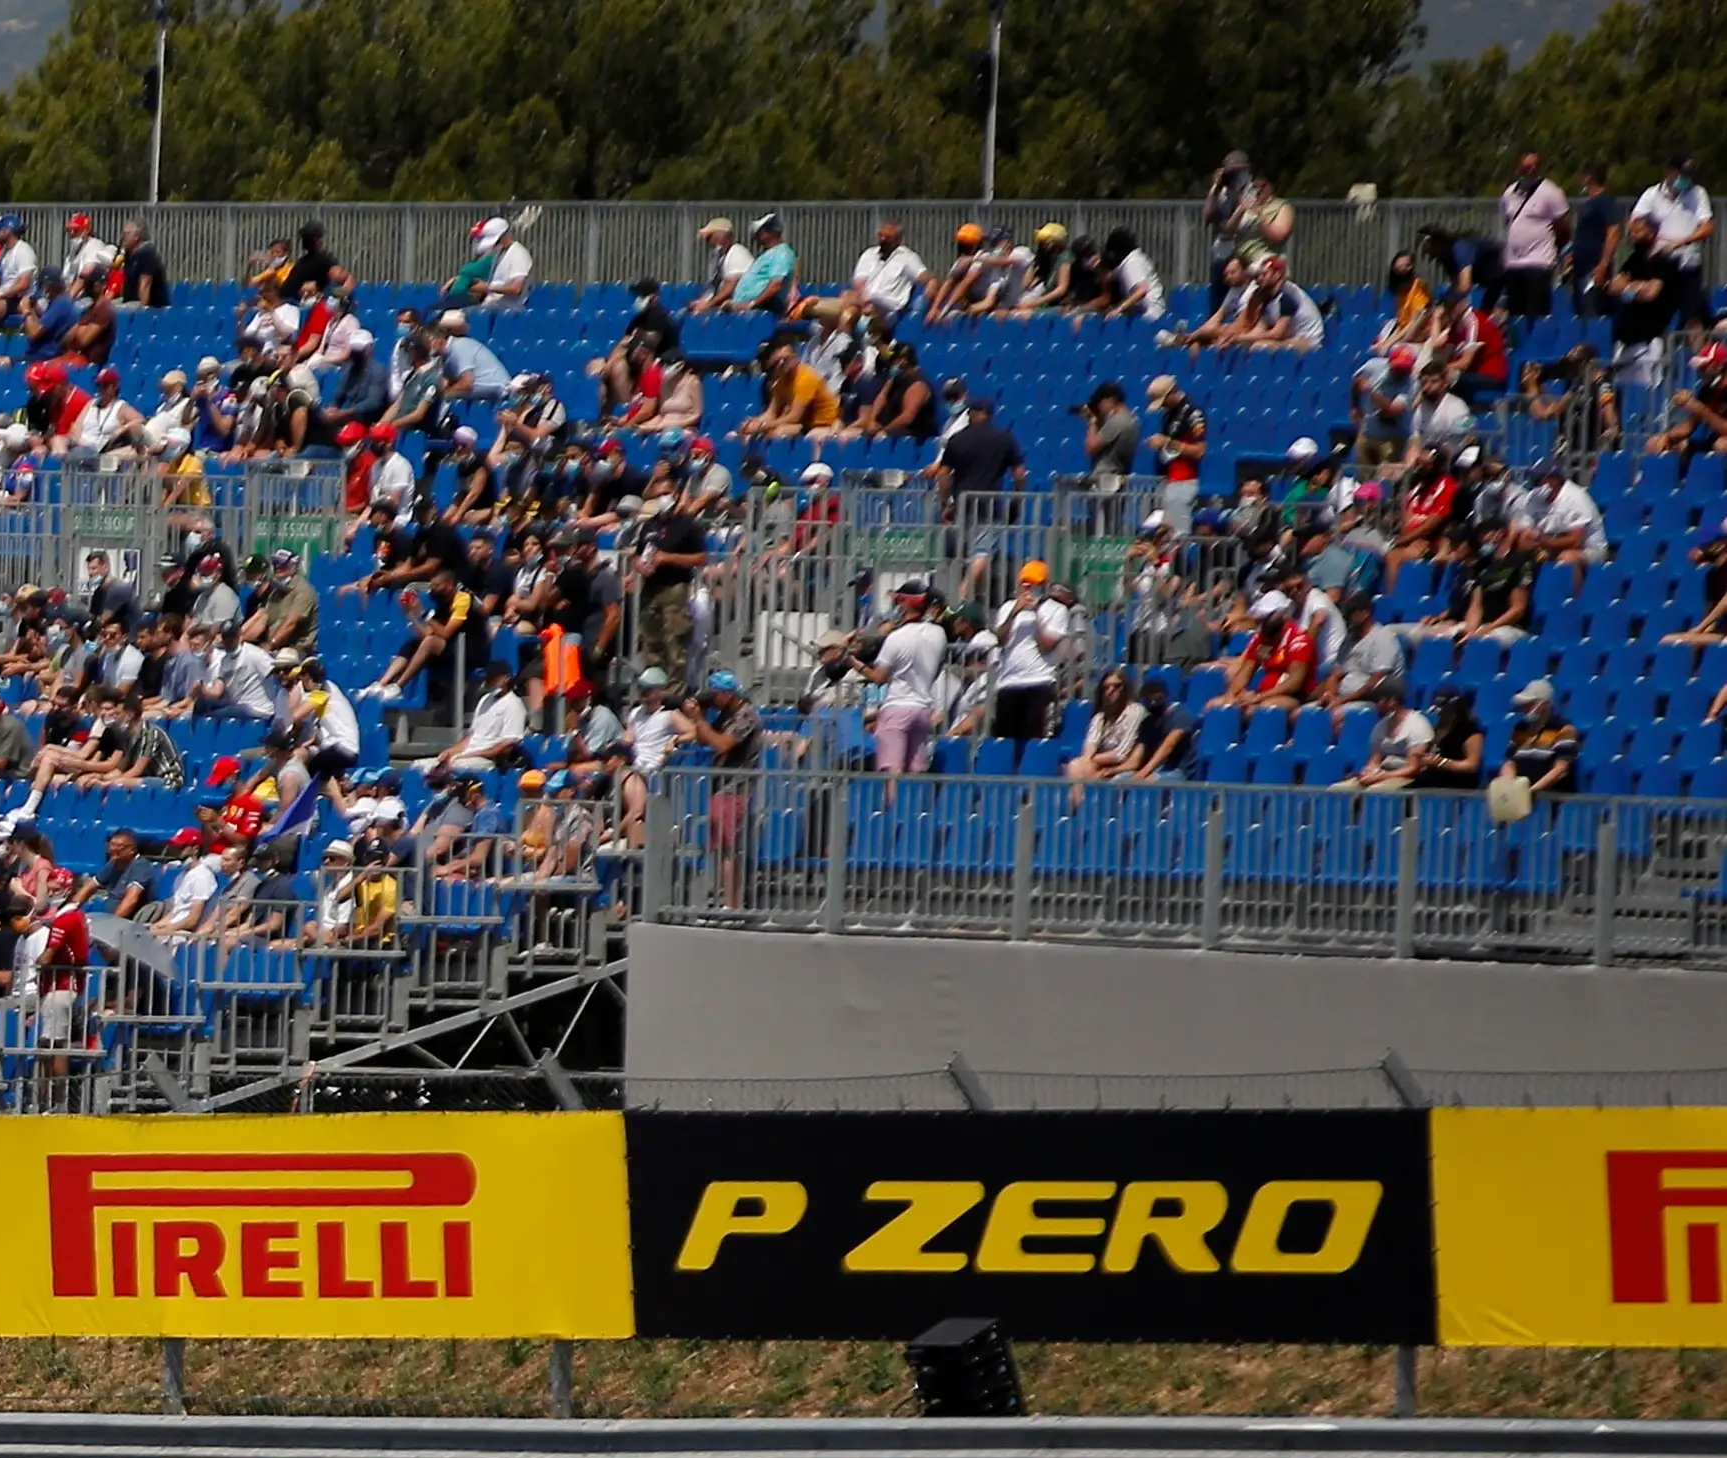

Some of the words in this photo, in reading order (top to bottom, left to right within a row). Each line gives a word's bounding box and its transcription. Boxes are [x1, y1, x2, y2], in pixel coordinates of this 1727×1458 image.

[46, 1153, 474, 1299] PIRELLI
[675, 1180, 808, 1271] P
[843, 1180, 1383, 1274] ZERO
